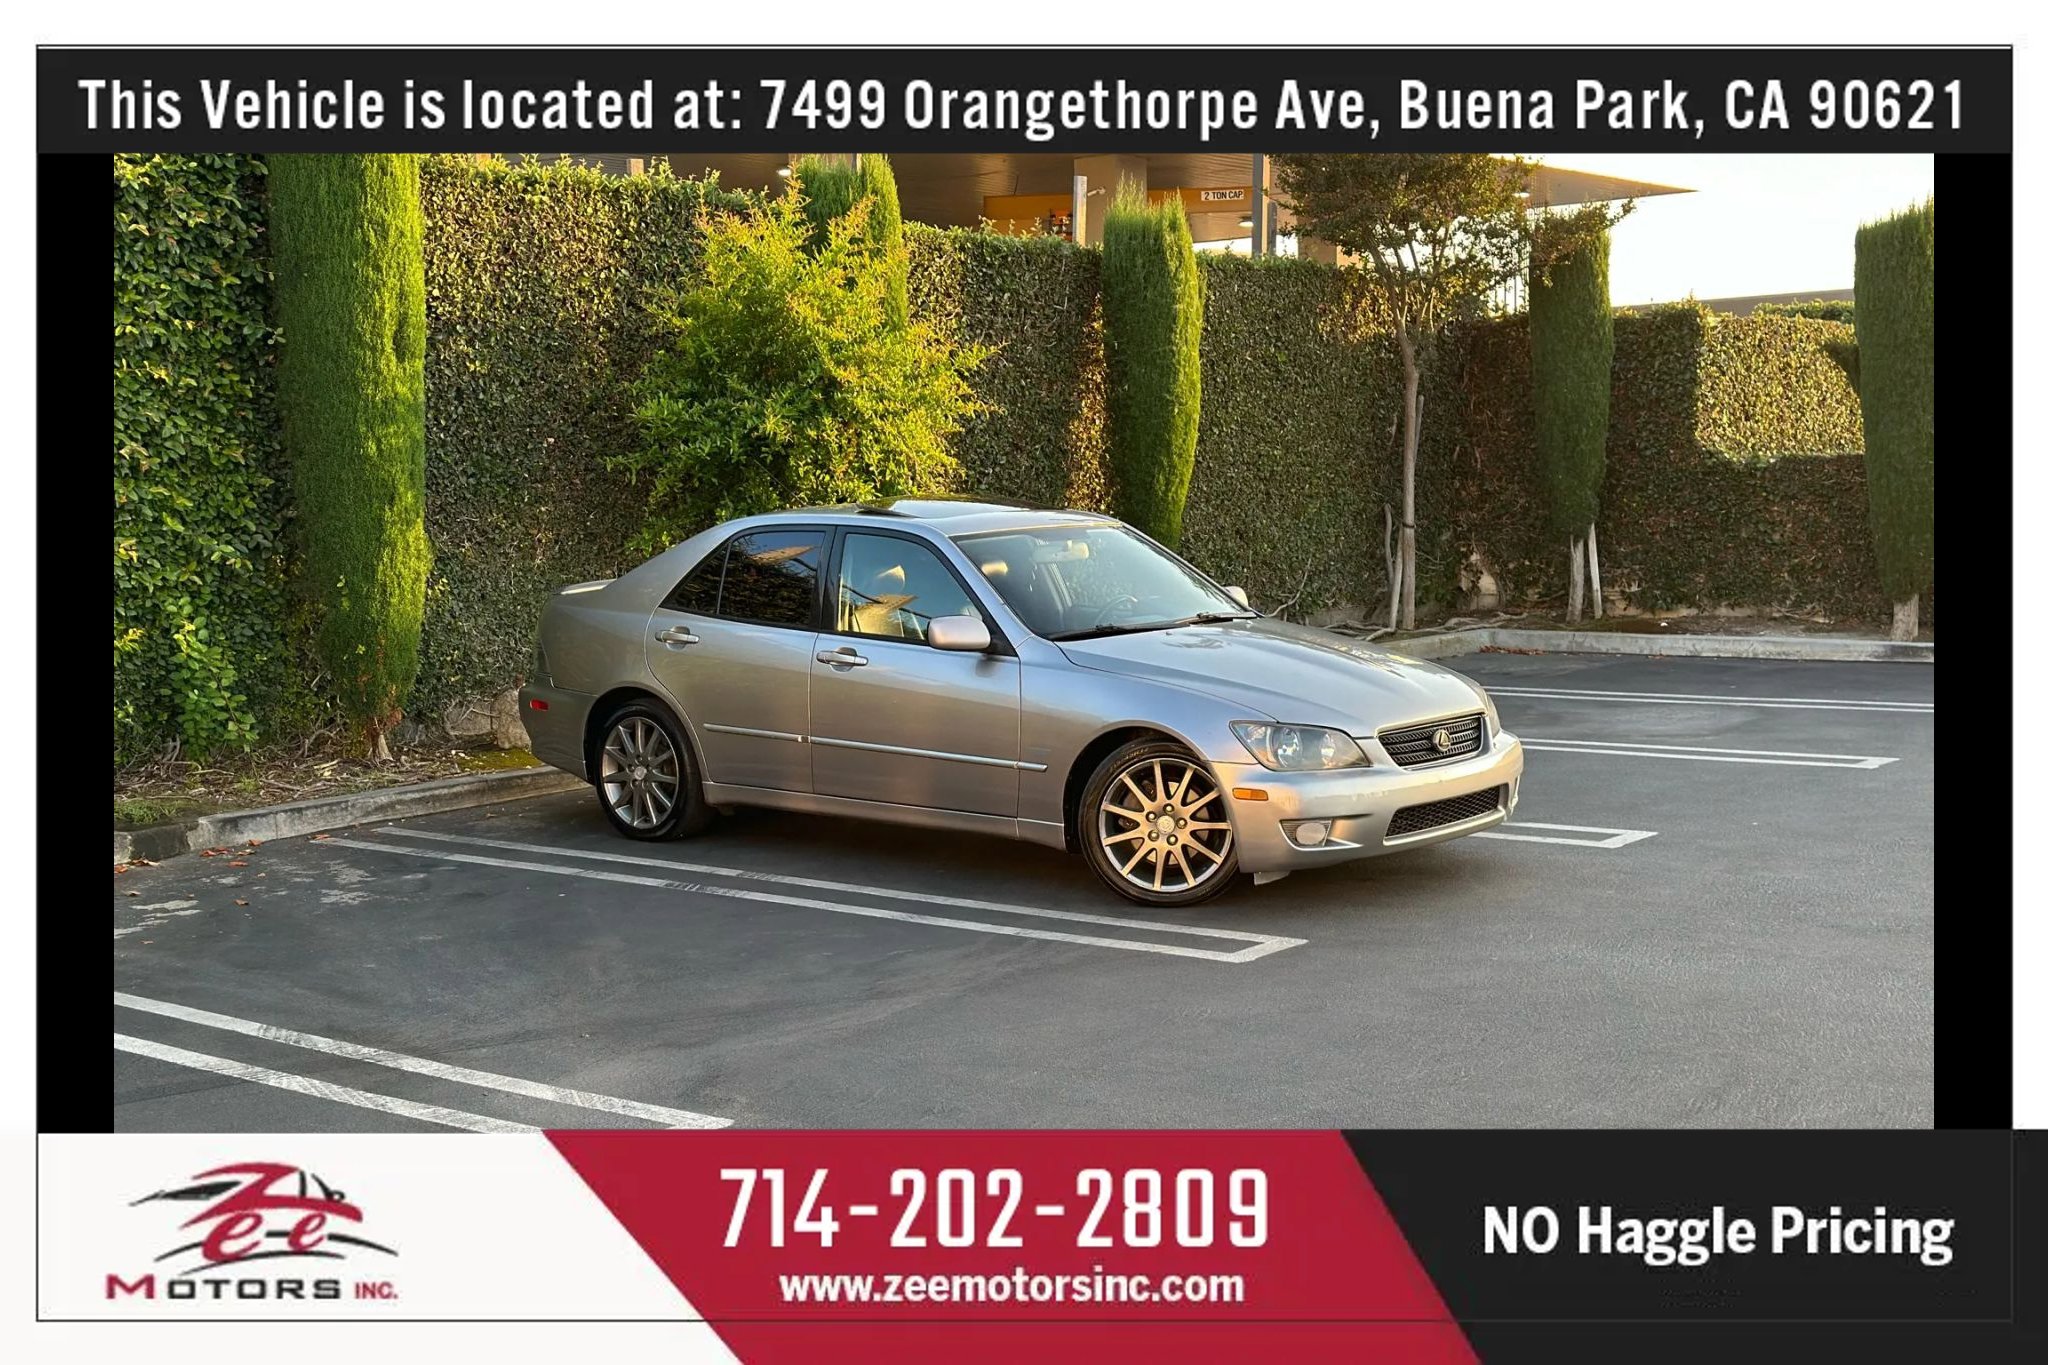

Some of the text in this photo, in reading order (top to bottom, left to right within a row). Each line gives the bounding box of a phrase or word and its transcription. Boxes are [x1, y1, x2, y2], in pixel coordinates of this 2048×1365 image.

[1204, 190, 1243, 200] 2 TON CAP
